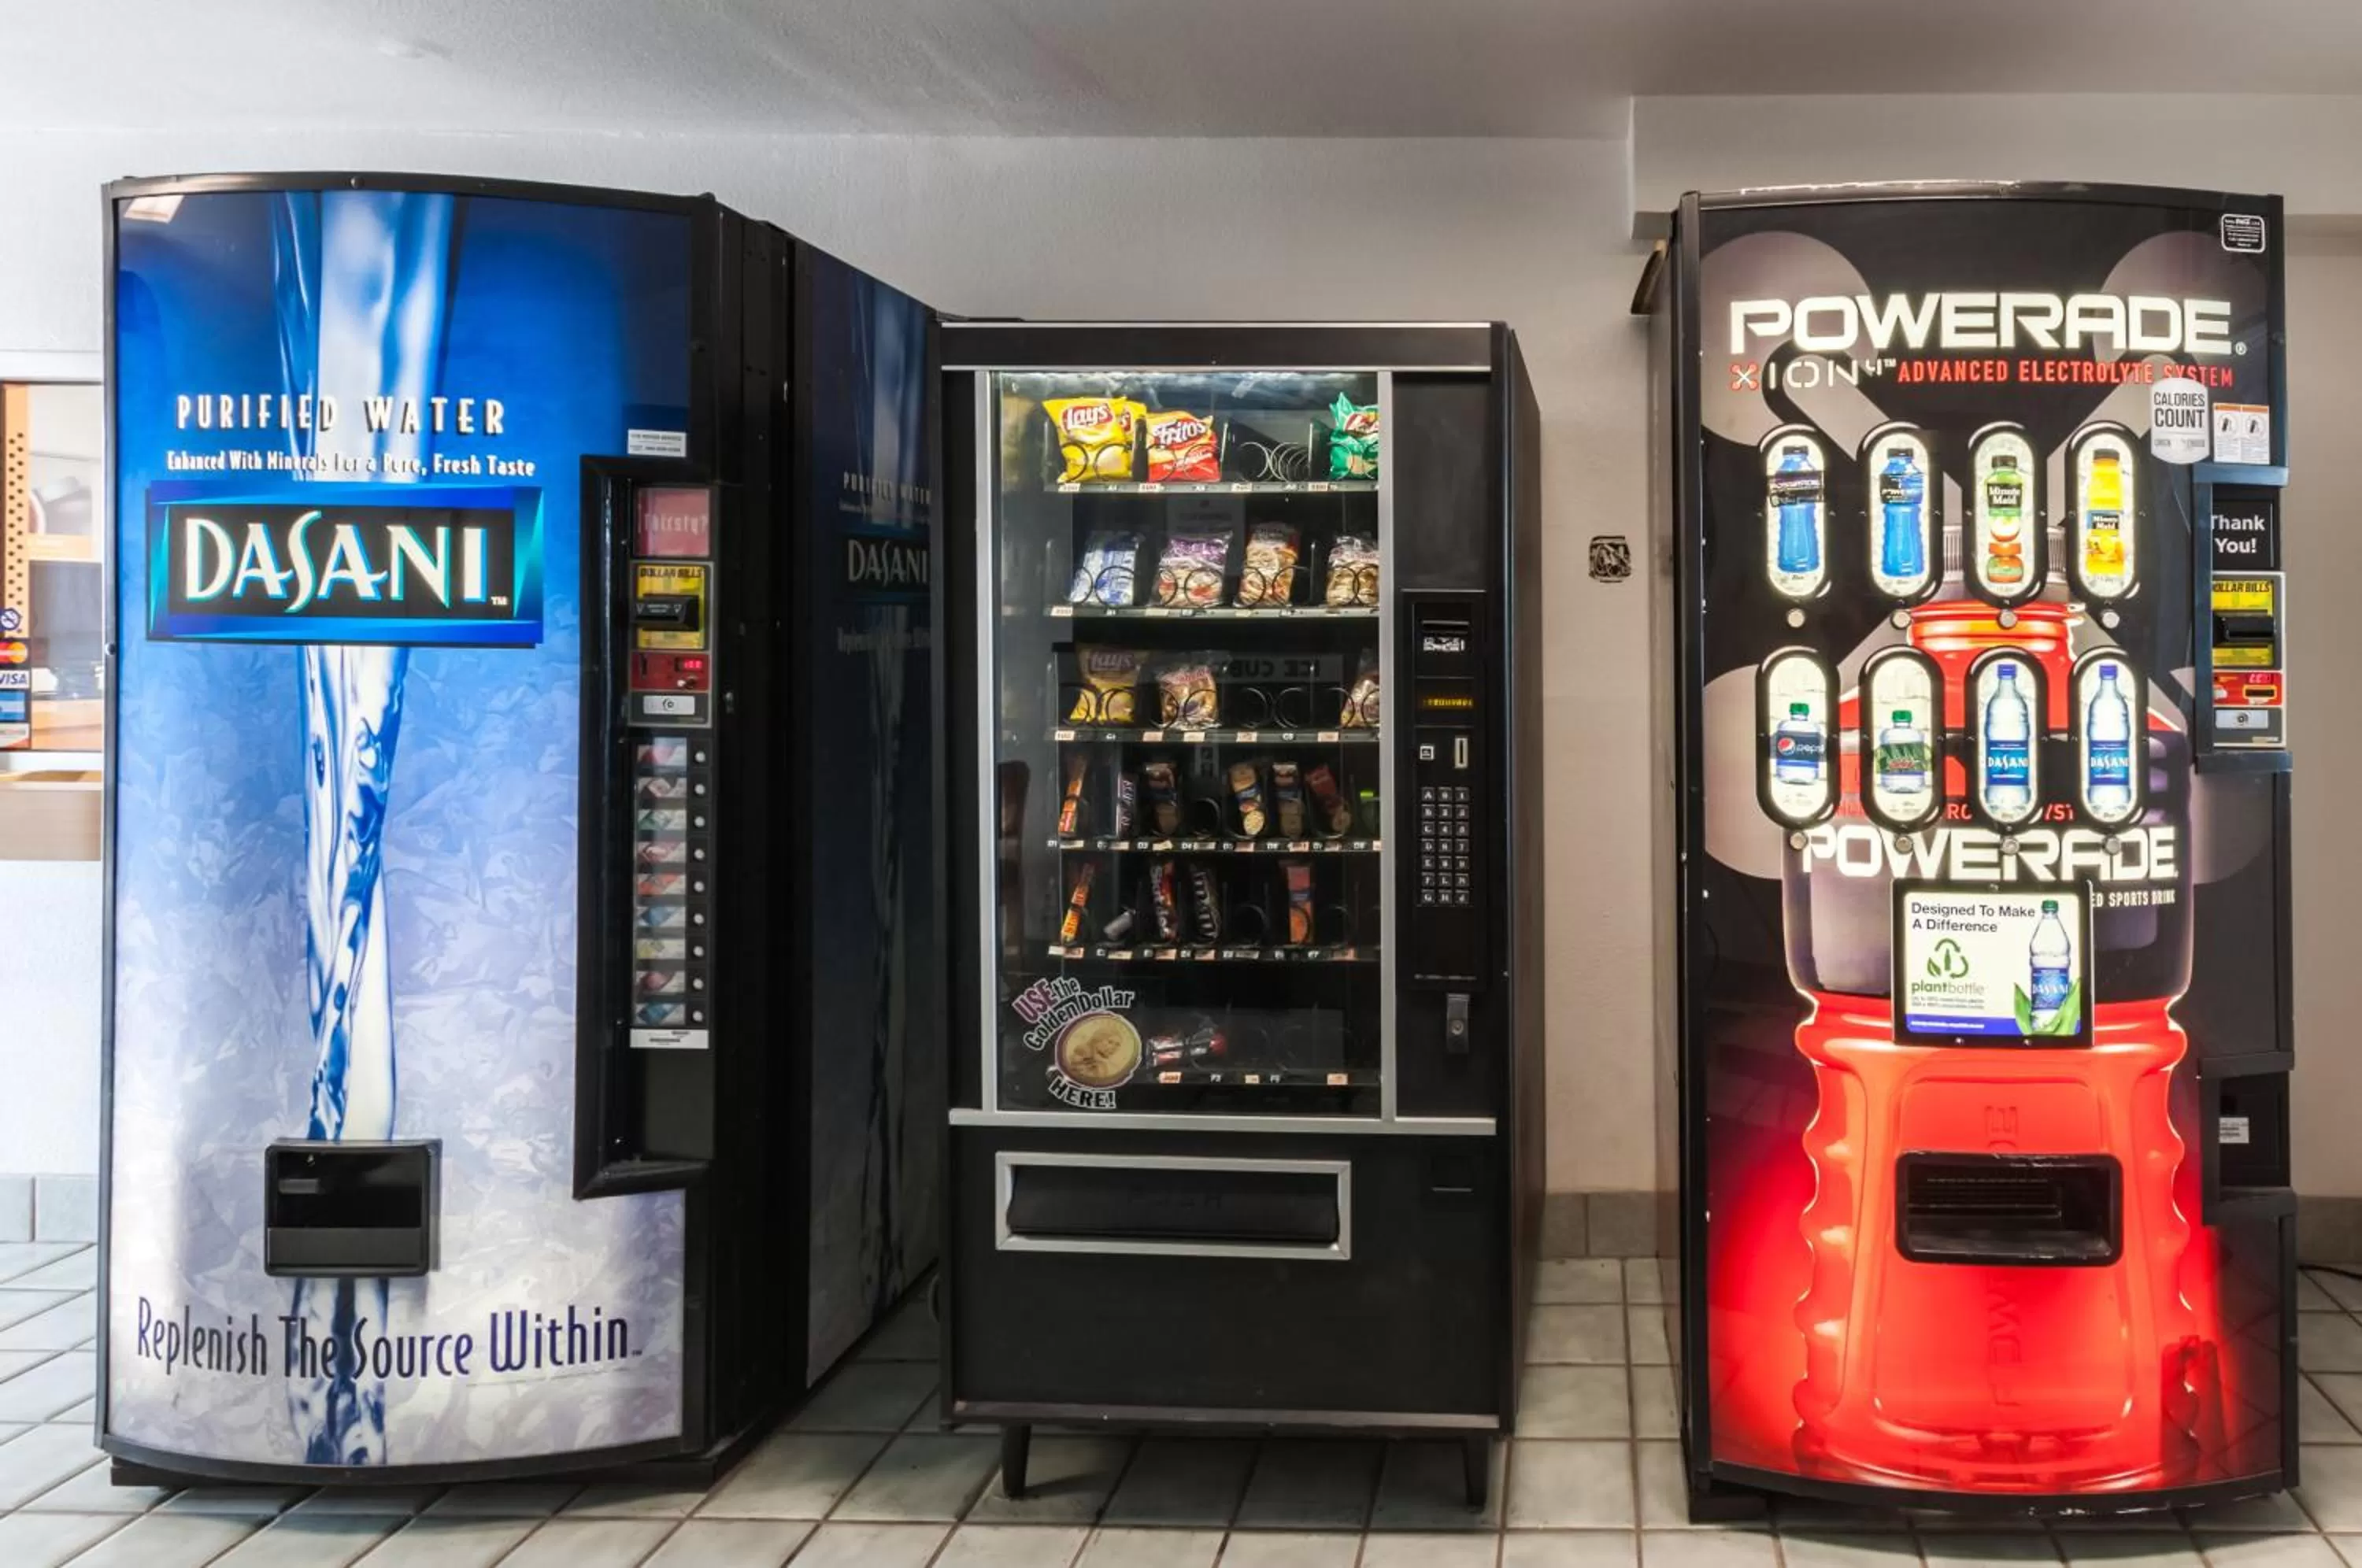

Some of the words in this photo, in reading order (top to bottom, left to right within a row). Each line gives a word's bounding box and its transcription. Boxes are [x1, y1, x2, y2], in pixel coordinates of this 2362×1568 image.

[1731, 292, 2232, 355] POWERADE
[1898, 360, 2008, 383] ADVANCED
[2020, 361, 2153, 384] ELECTROLYTE
[2164, 364, 2233, 387] SYSTEM
[2154, 392, 2205, 407] CALORIES
[176, 394, 339, 431] PURIFIED
[364, 396, 505, 435] WATER
[2155, 408, 2205, 428] COUNT
[1151, 420, 1206, 446] Fritos
[167, 450, 226, 471] Enhanced
[229, 450, 263, 471] With
[434, 453, 481, 475] Fresh
[487, 454, 536, 476] Taste
[2211, 515, 2265, 531] Thank
[2216, 538, 2256, 553] You!
[184, 509, 487, 613] DASANI
[848, 539, 927, 586] DASANI
[1803, 824, 2176, 880] POWERADE
[1911, 902, 1975, 918] Designed
[1979, 905, 1995, 917] To
[1999, 906, 2035, 918] Make
[2109, 891, 2149, 908] SPORTS
[2152, 889, 2176, 904] DRINK
[1912, 919, 1922, 930] A
[1927, 919, 1998, 933] Difference
[1013, 978, 1057, 1023] USE
[1052, 977, 1079, 999] the
[1912, 979, 1985, 995] plantbottle
[1024, 997, 1078, 1049] Golden
[1079, 986, 1135, 1013] Dollar
[1049, 1077, 1116, 1108] HERE!
[137, 1296, 268, 1377] Replenish
[278, 1315, 335, 1379] The
[353, 1317, 472, 1381] Source
[489, 1304, 629, 1372] Within
